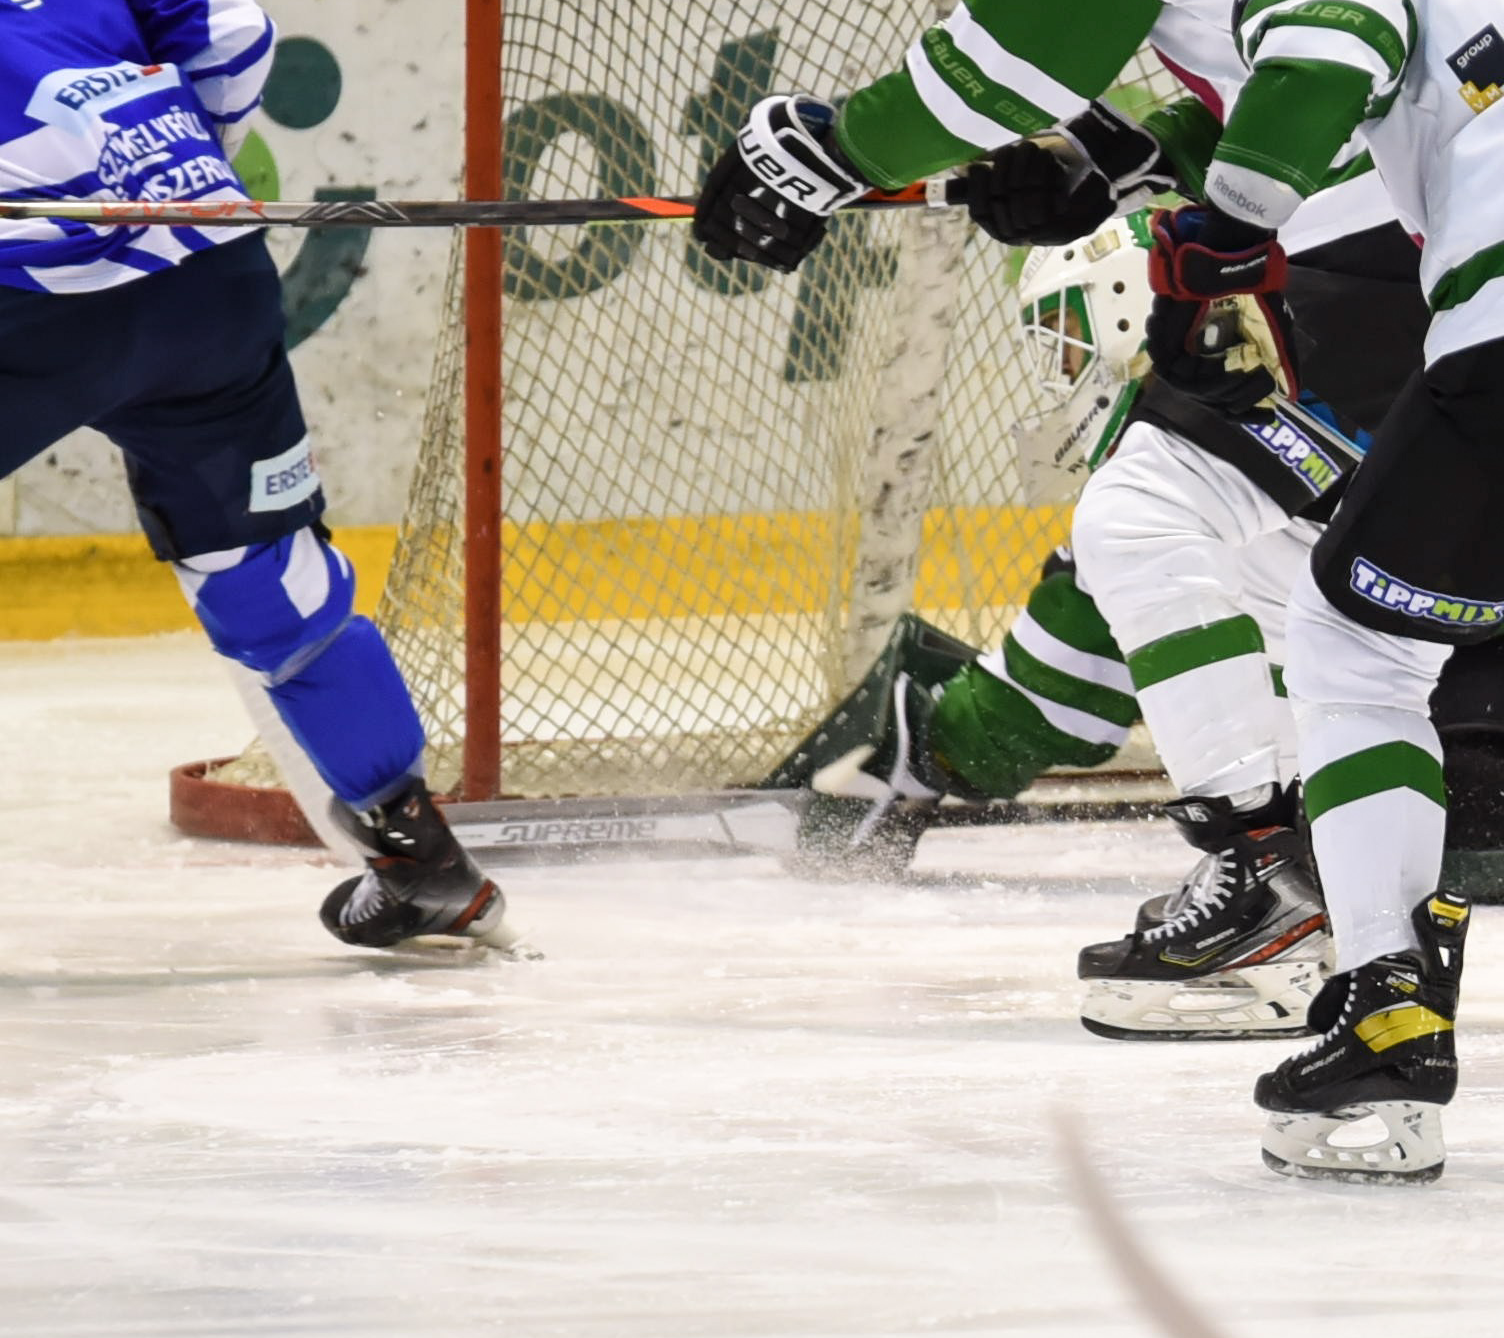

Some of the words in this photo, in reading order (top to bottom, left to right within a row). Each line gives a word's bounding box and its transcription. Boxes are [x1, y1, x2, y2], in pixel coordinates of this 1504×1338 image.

[1456, 32, 1494, 69] group
[54, 67, 139, 111] ERSTE
[739, 127, 818, 203] UER
[1213, 175, 1269, 219] Reebok
